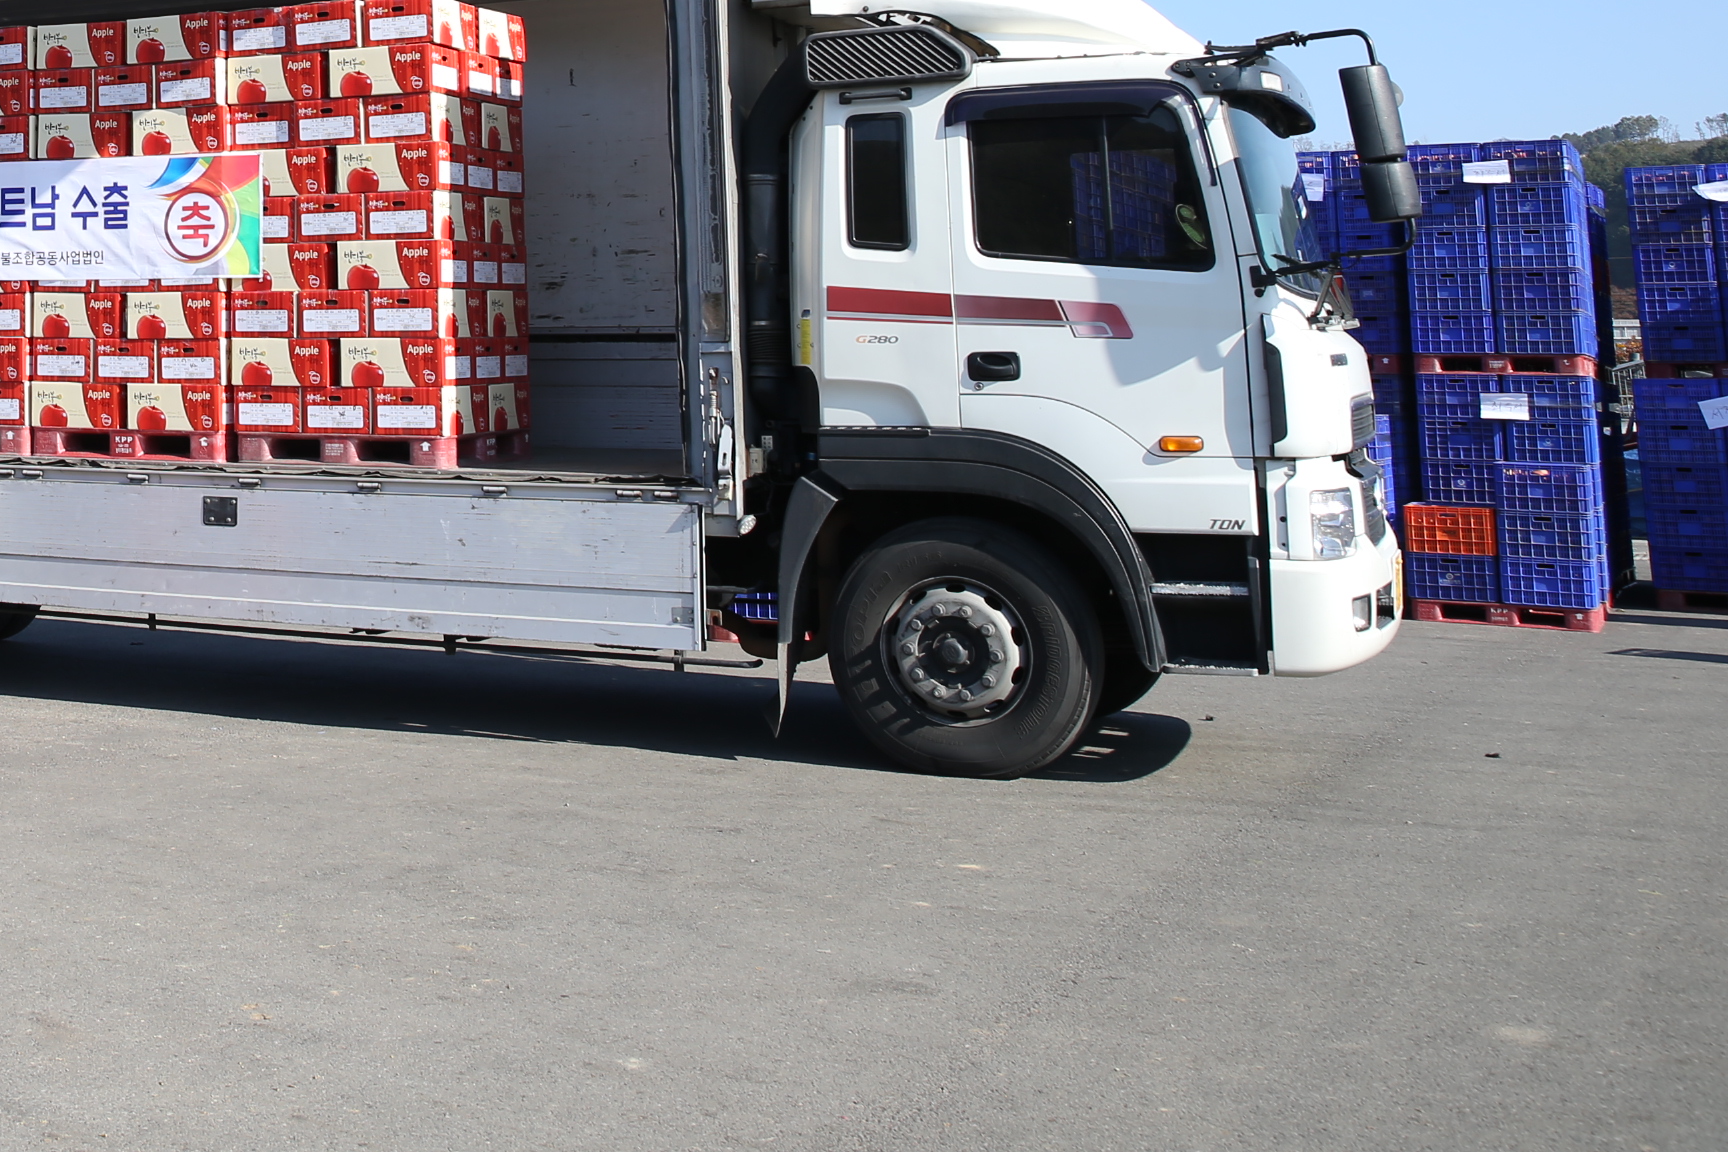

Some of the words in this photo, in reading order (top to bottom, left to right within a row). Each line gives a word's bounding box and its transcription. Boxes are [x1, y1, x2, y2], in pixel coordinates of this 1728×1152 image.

[462, 10, 472, 21] Apple
[186, 18, 208, 28] Apple
[509, 22, 521, 32] Apple
[92, 28, 113, 37] Apple
[395, 51, 420, 63] Apple
[288, 60, 311, 70] Apple
[192, 113, 215, 122] Apple
[95, 120, 117, 129] Apple
[401, 148, 427, 159] Apple
[292, 154, 316, 165] Apple
[71, 181, 130, 231] 수출
[176, 200, 216, 247] 축
[294, 250, 318, 260] Apple
[403, 247, 428, 258] Apple
[90, 299, 112, 309] Apple
[187, 299, 210, 308] Apple
[856, 335, 899, 344] G280
[294, 346, 319, 356] Apple
[407, 344, 433, 355] Apple
[88, 390, 110, 399] Apple
[187, 391, 210, 401] Apple
[1209, 519, 1246, 530] TON
